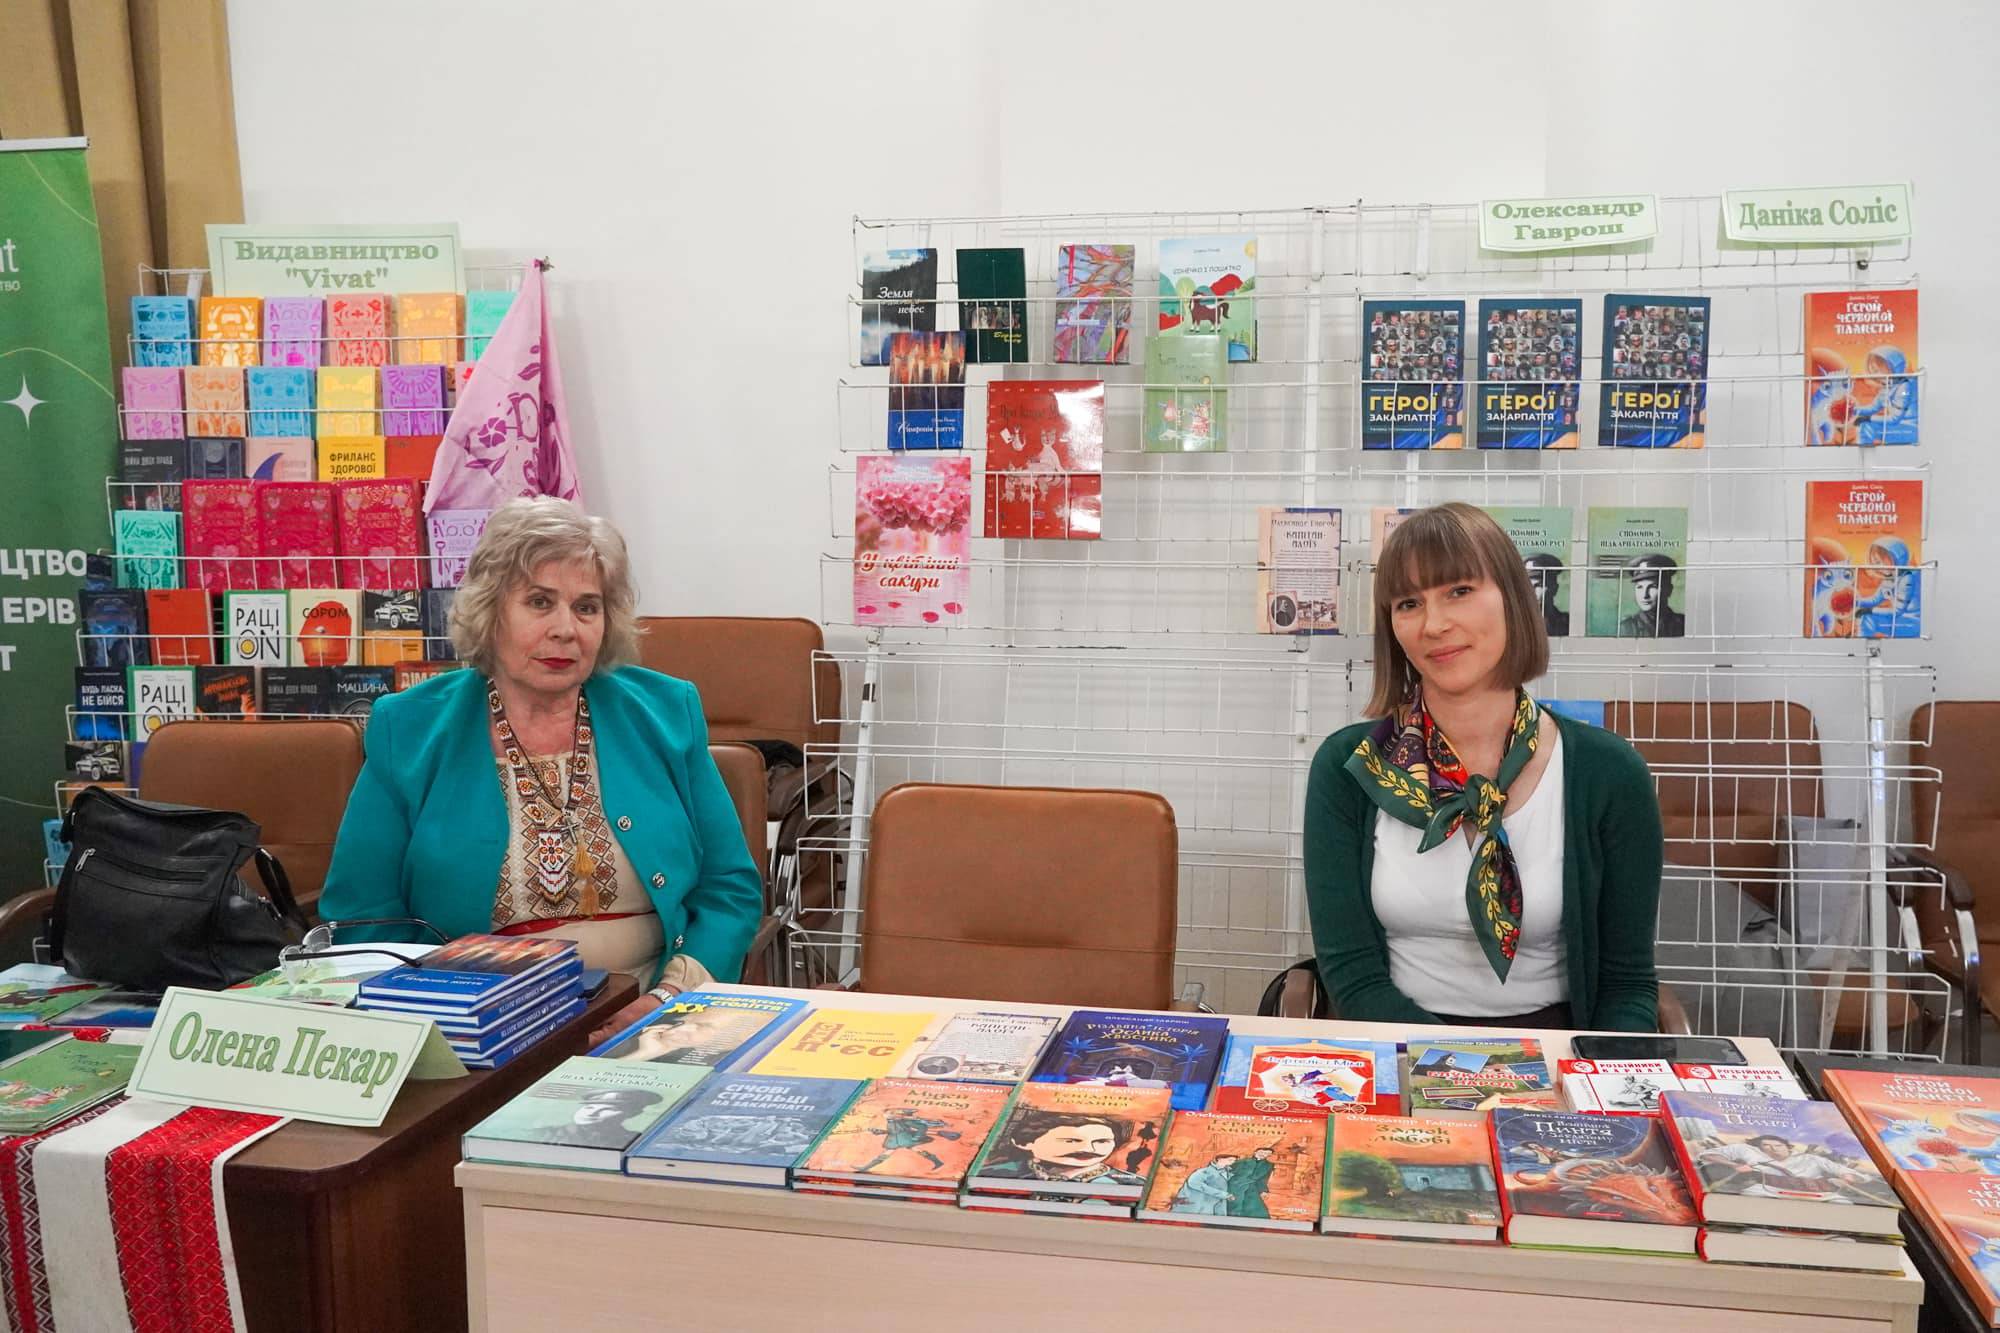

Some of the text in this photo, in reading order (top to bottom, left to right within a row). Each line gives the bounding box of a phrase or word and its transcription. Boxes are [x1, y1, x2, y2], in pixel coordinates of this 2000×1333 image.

[1491, 201, 1645, 220] Олександр
[1739, 196, 1898, 230] Даніка Соліс
[1514, 222, 1625, 241] Гаврош
[234, 240, 439, 262] Видавництво
[285, 266, 389, 289] "Vivat"
[877, 286, 914, 299] Земля
[897, 305, 925, 314] небес
[1369, 392, 1438, 411] ГЕРОЇ
[1486, 390, 1556, 410] ГЕРОЇ
[1610, 389, 1681, 409] ГЕРОЇ
[1369, 414, 1436, 422] ЗАКАРПАТТЯ
[1486, 413, 1554, 421] ЗАКАРПАТТЯ
[1610, 410, 1679, 420] ЗАКАРПАТТЯ
[329, 452, 376, 462] ФРИЛАНС
[329, 463, 376, 475] ЗДОРОВОЇ
[879, 575, 941, 593] сакури
[2, 597, 76, 624] ЕРІВ
[302, 608, 349, 619] СОРОМ
[236, 608, 280, 631] РАЦІ
[82, 685, 100, 694] БУДЬ
[337, 682, 390, 693] МАШИНА
[82, 694, 124, 706] НЕ БІЙСЯ
[141, 684, 186, 706] РАЦІ
[168, 1011, 400, 1099] Олена Пекар
[725, 1083, 791, 1095] СІЧОВІ
[1453, 1079, 1517, 1089] НАРОД
[717, 1092, 809, 1104] СТРІЛЬЦІ
[731, 1101, 816, 1111] ЗАКАРПАТТІ
